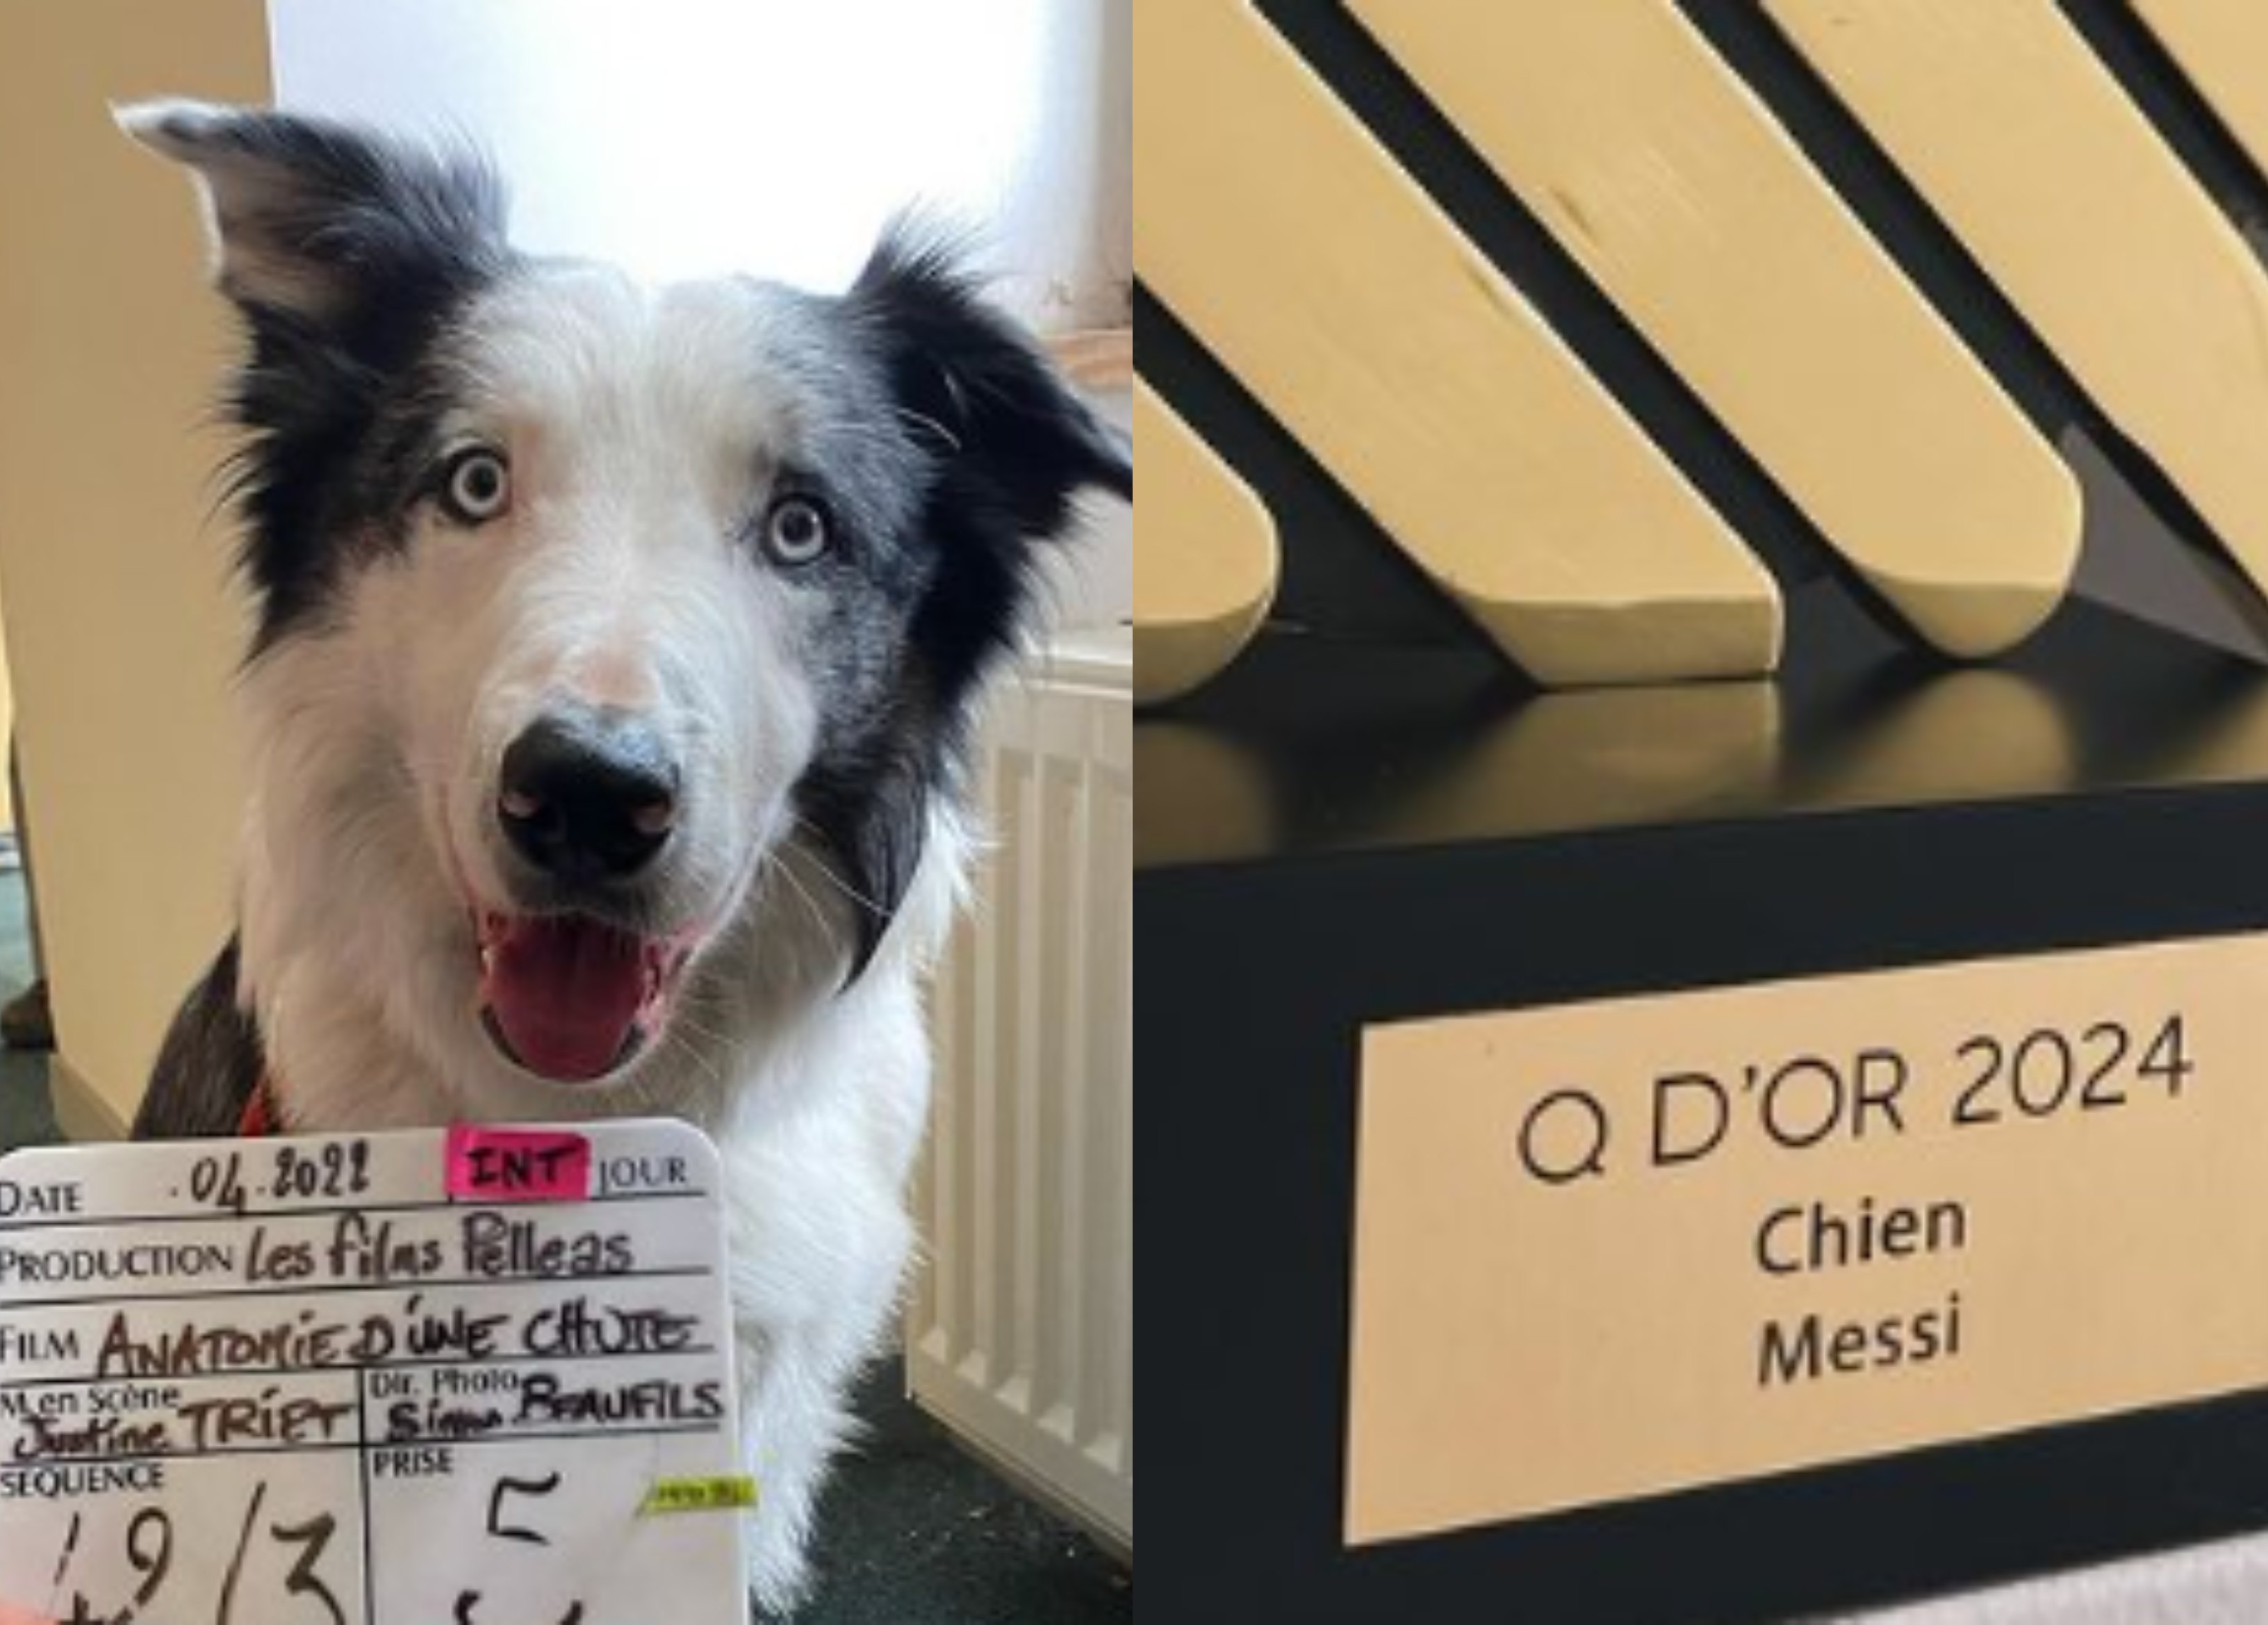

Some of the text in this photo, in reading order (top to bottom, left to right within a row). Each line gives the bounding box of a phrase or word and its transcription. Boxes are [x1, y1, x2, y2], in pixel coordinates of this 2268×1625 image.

[1518, 1014, 2193, 1185] Q D’OR 2024
[467, 1145, 580, 1190] INT
[600, 1157, 687, 1194] JOUR
[0, 1180, 83, 1216] DATE
[246, 1225, 315, 1284] Les
[1755, 1196, 1966, 1275] Chien
[0, 1245, 233, 1283] PRODUCTION
[0, 1329, 81, 1362] FILM
[1757, 1291, 1961, 1388] Messi
[432, 1367, 519, 1395] Photo
[373, 1448, 454, 1478] PRISE
